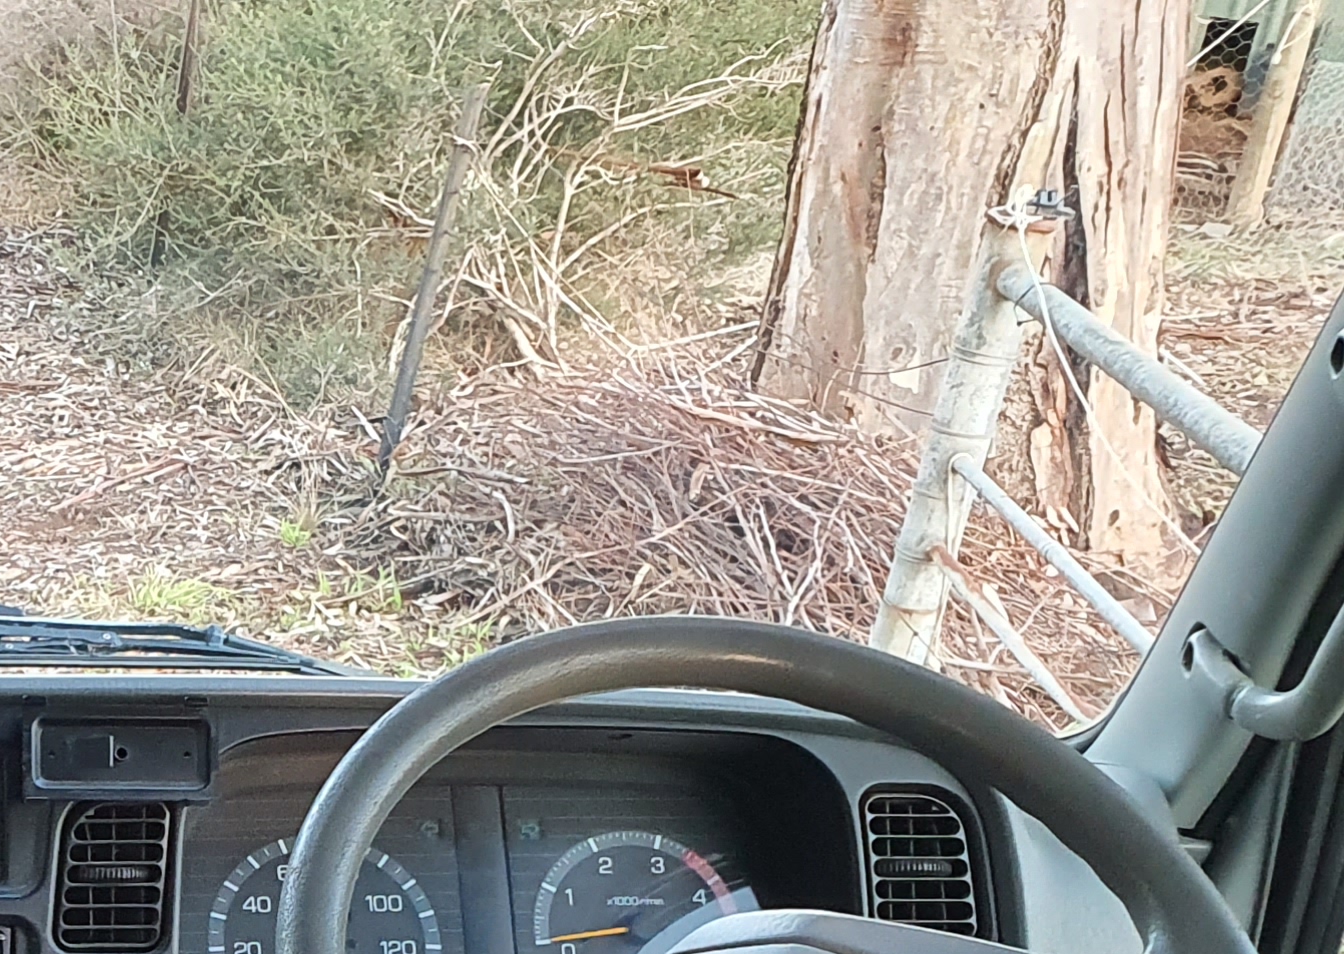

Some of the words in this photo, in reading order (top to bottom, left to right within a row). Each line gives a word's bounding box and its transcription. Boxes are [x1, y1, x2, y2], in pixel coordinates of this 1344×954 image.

[598, 856, 613, 875] 2
[650, 856, 665, 875] 3
[242, 895, 272, 913] 40
[364, 894, 403, 913] 100
[564, 888, 574, 906] 1
[692, 888, 707, 906] 4
